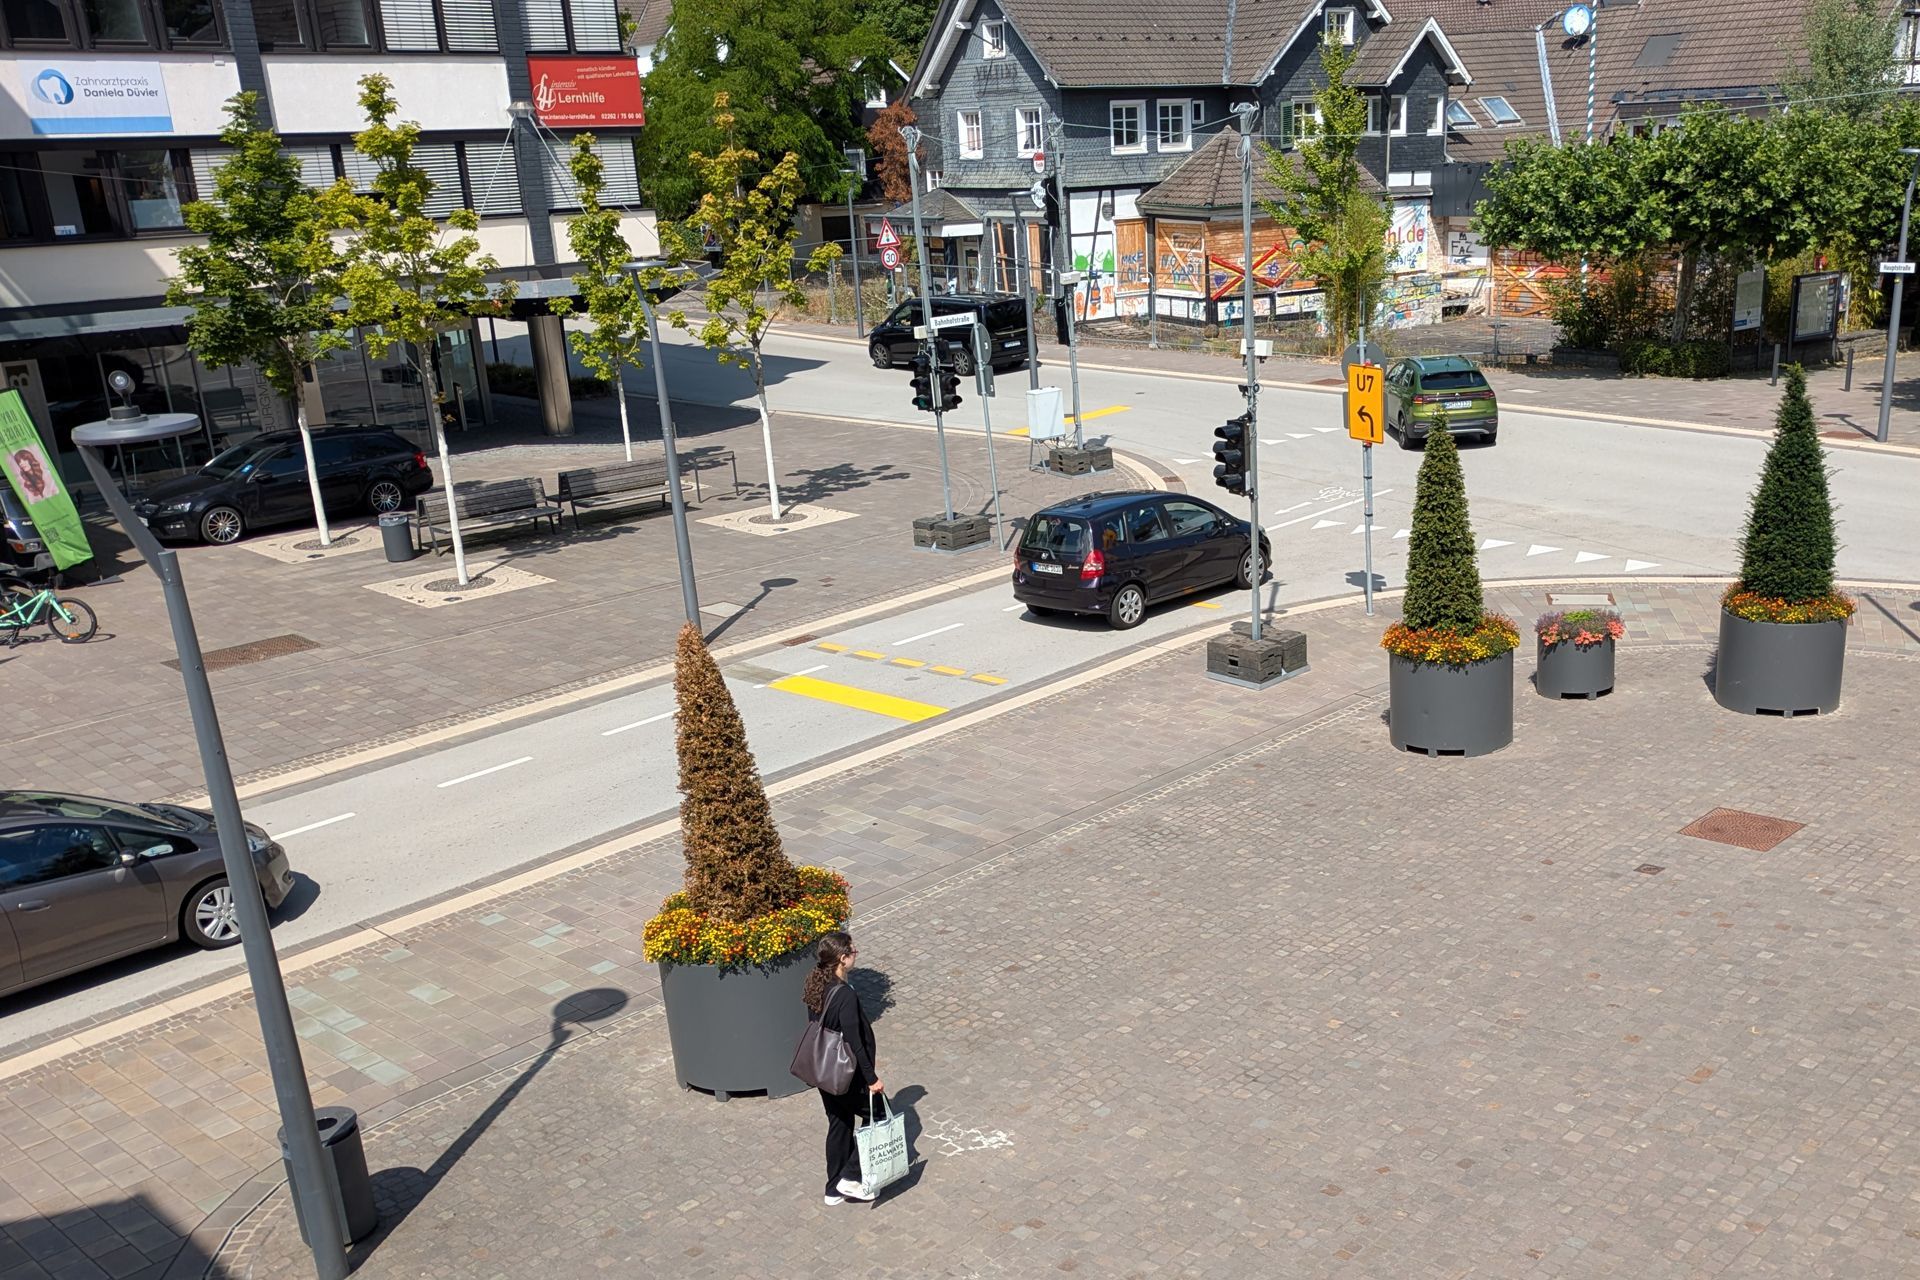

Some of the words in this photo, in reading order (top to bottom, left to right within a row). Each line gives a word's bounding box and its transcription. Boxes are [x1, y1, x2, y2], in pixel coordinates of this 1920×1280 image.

[74, 76, 149, 87] Zahnarztpraxis
[550, 80, 577, 89] intensiv
[83, 88, 124, 97] Daniela
[127, 87, 159, 97] Düvier
[558, 92, 606, 104] Lernhilfe
[886, 253, 896, 263] 30
[1882, 264, 1911, 273] Hauptstraße
[934, 315, 970, 327] Bahnhofstraße
[1356, 373, 1375, 393] U7
[868, 1135, 903, 1155] SHOPPING
[869, 1154, 876, 1162] IS
[878, 1141, 904, 1158] ALWAYS
[875, 1155, 893, 1166] GOOD
[892, 1149, 905, 1158] IDEA
